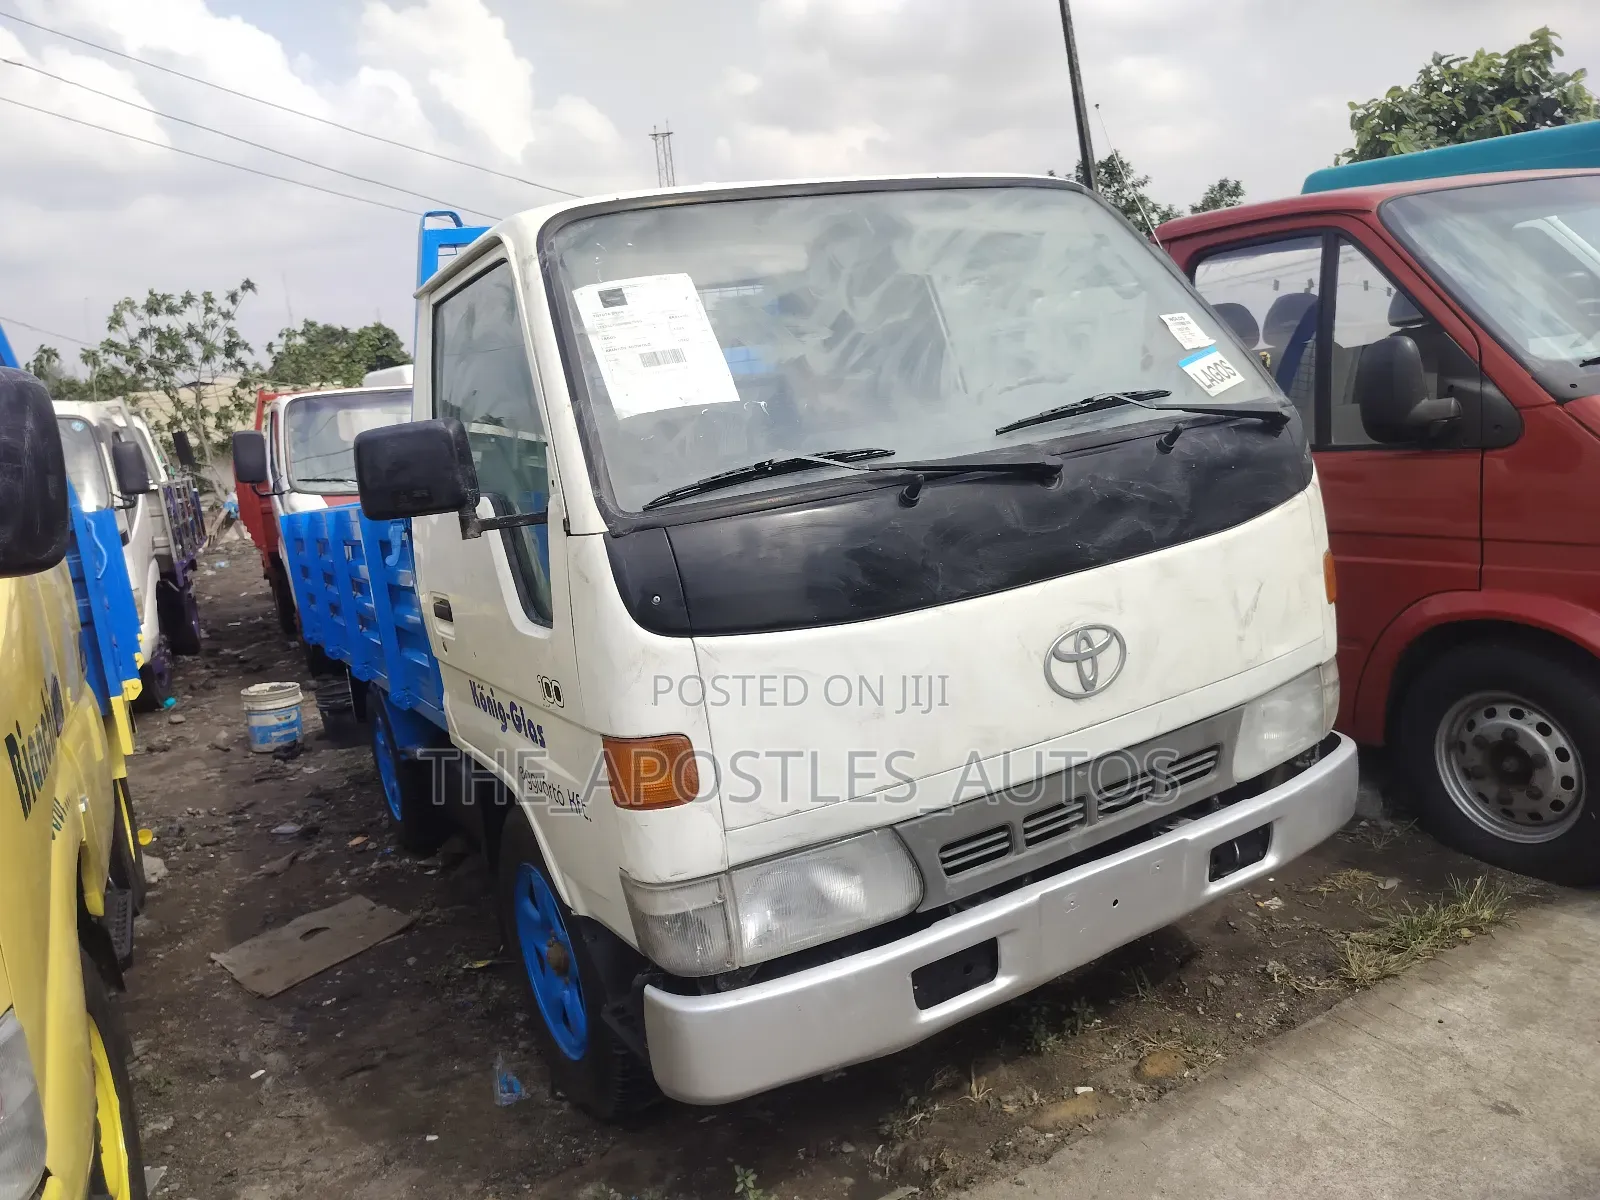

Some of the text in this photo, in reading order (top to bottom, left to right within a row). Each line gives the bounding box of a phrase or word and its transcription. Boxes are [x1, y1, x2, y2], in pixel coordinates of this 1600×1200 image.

[1192, 359, 1237, 390] LAGOS
[469, 680, 546, 748] König-Glas
[5, 677, 57, 821] Bianchi
